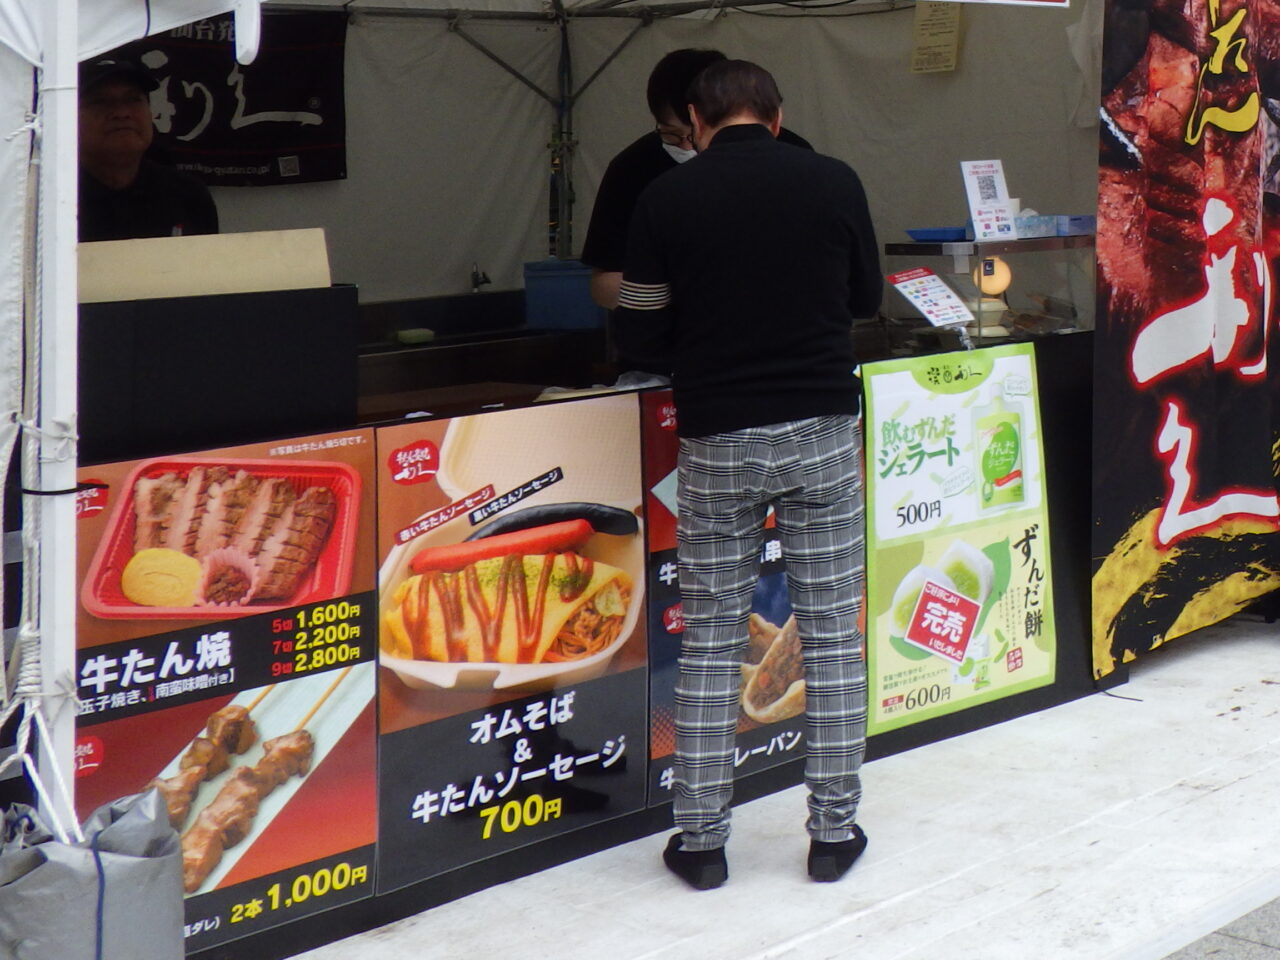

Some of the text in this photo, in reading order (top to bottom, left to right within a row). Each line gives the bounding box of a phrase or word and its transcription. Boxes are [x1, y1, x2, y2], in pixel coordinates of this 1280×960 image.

[881, 413, 957, 447] 飲むずんだ
[878, 436, 960, 480] ジェラート
[399, 487, 491, 542] 赤い牛たんソーセージ
[473, 470, 559, 524] 黒い牛たんソーセージ
[896, 499, 942, 528] 500円
[1013, 523, 1045, 639] ずんだ餅
[294, 623, 361, 652] 2,200円
[296, 602, 361, 630] 1,600円
[920, 600, 967, 644] 完売
[80, 631, 232, 693] 牛たん焼
[294, 644, 361, 672] 2,800円
[469, 691, 576, 745] オムそば
[905, 683, 951, 711] 600円
[513, 740, 533, 764] &
[412, 735, 627, 825] 牛たんソーセージ
[480, 794, 562, 840] 700円
[230, 862, 368, 924] 2本 1,000円
